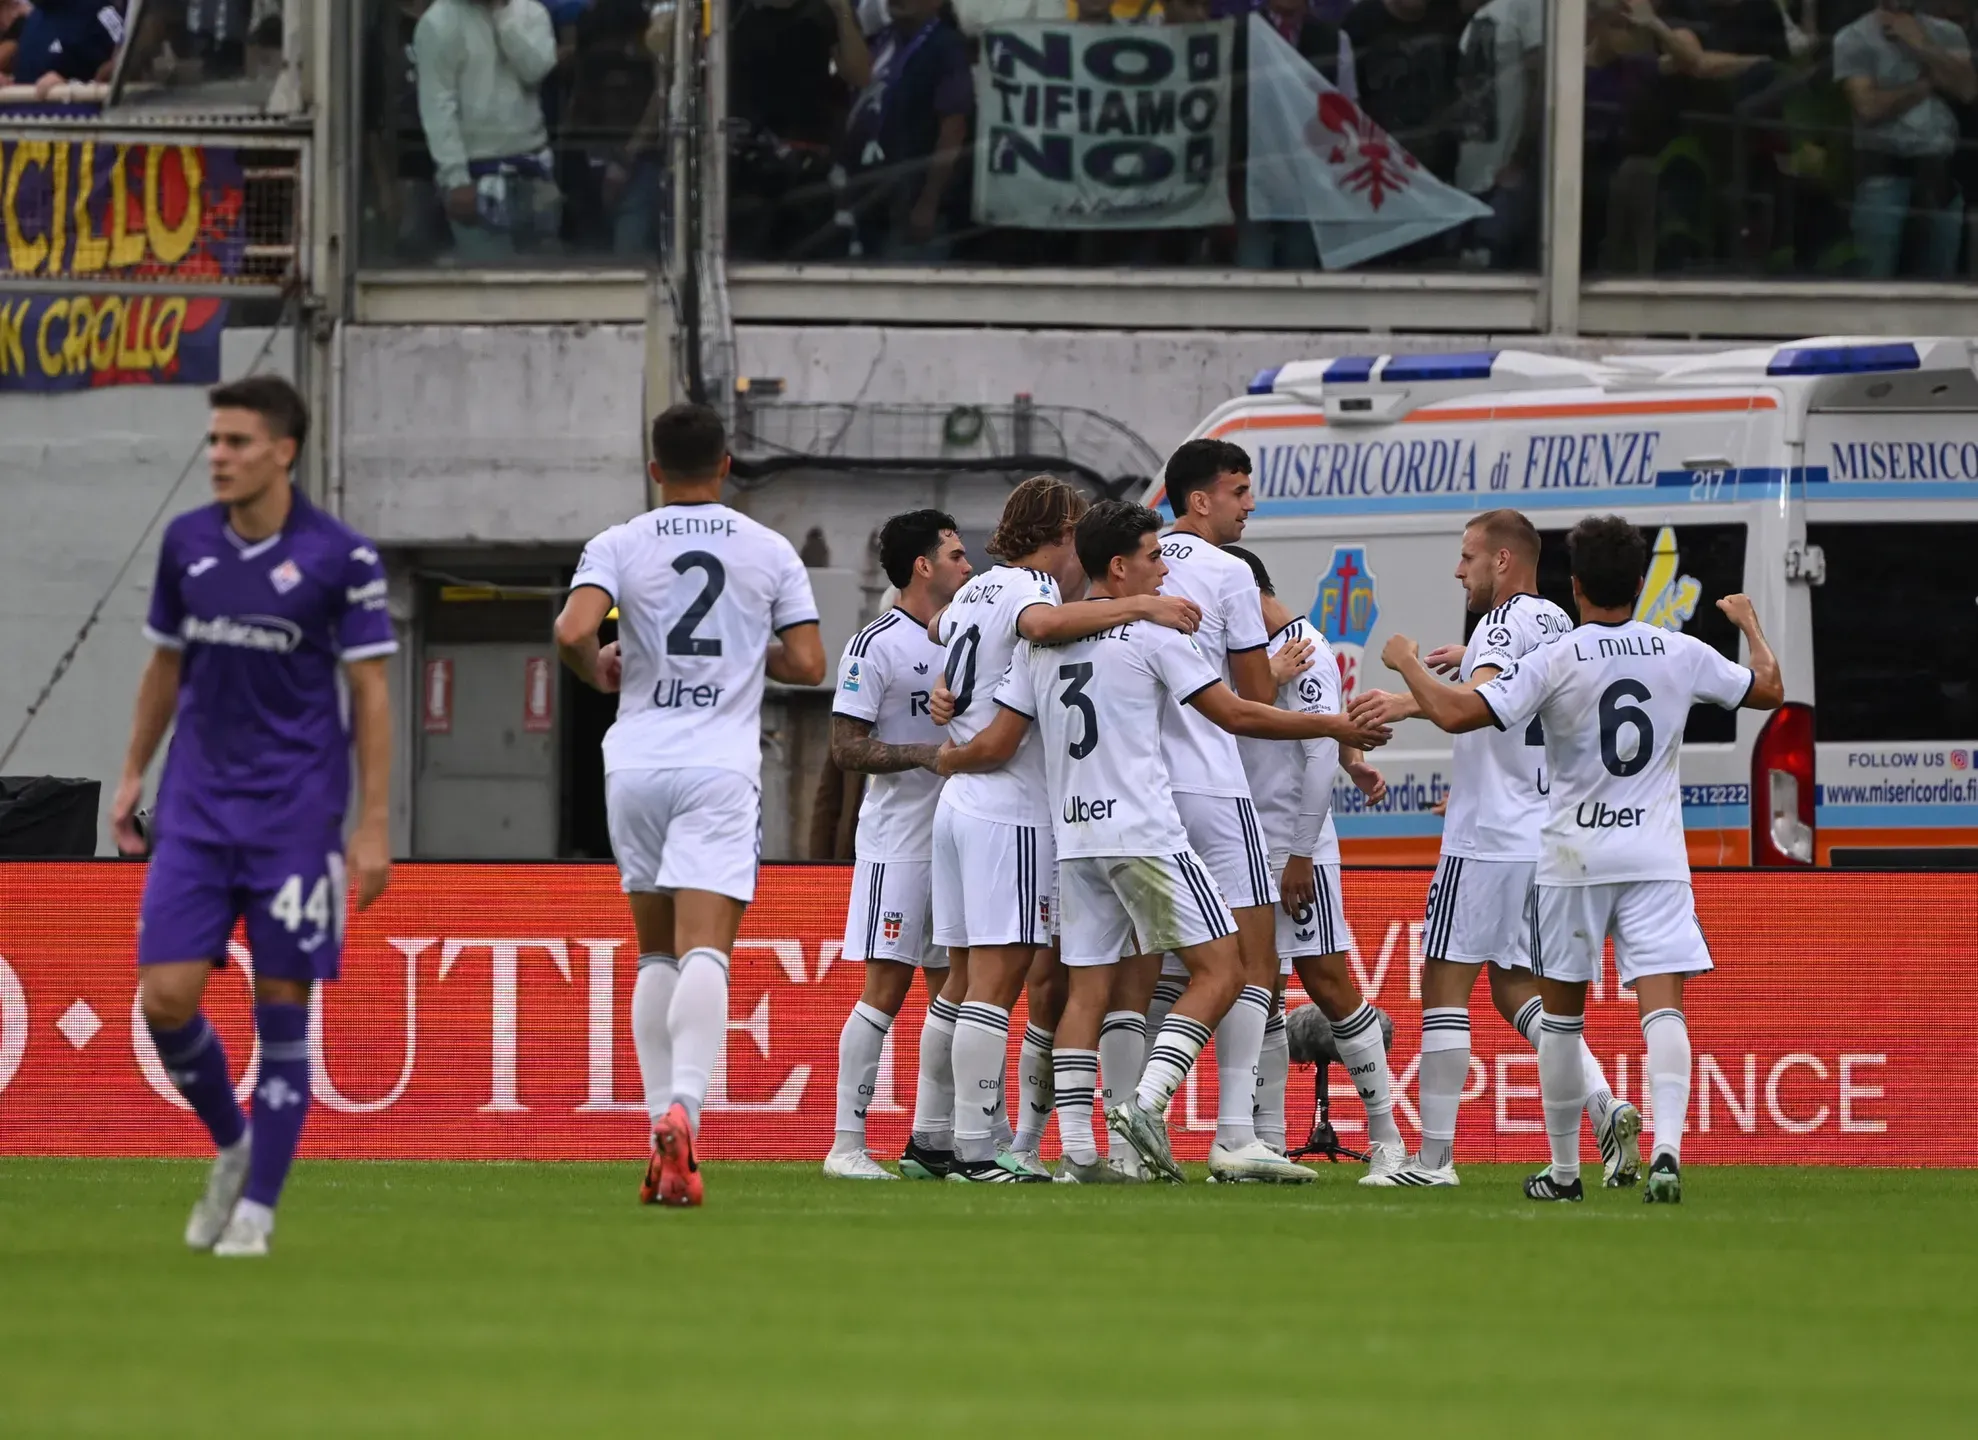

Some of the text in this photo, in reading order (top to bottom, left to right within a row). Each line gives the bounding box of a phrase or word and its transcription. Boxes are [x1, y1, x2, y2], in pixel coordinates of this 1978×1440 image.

[992, 79, 1217, 138] TIFIAMO
[0, 140, 202, 272] CILLO
[36, 294, 187, 377] CROLLO
[1255, 431, 1661, 498] MISERICORDIA di FIRENZE
[1830, 441, 1978, 480] MISERICO
[1690, 470, 1726, 501] 217
[656, 517, 738, 537] KEMPF
[666, 550, 726, 657] 2
[1574, 636, 1666, 662] L. MILLA
[652, 678, 726, 708] Uber
[1059, 661, 1099, 760] 3
[1598, 678, 1655, 778] 6
[1848, 752, 1945, 768] FOLLOW US
[1062, 795, 1118, 824] Uber
[1575, 801, 1646, 829] Uber
[269, 873, 329, 932] 44
[883, 911, 904, 919] COMO
